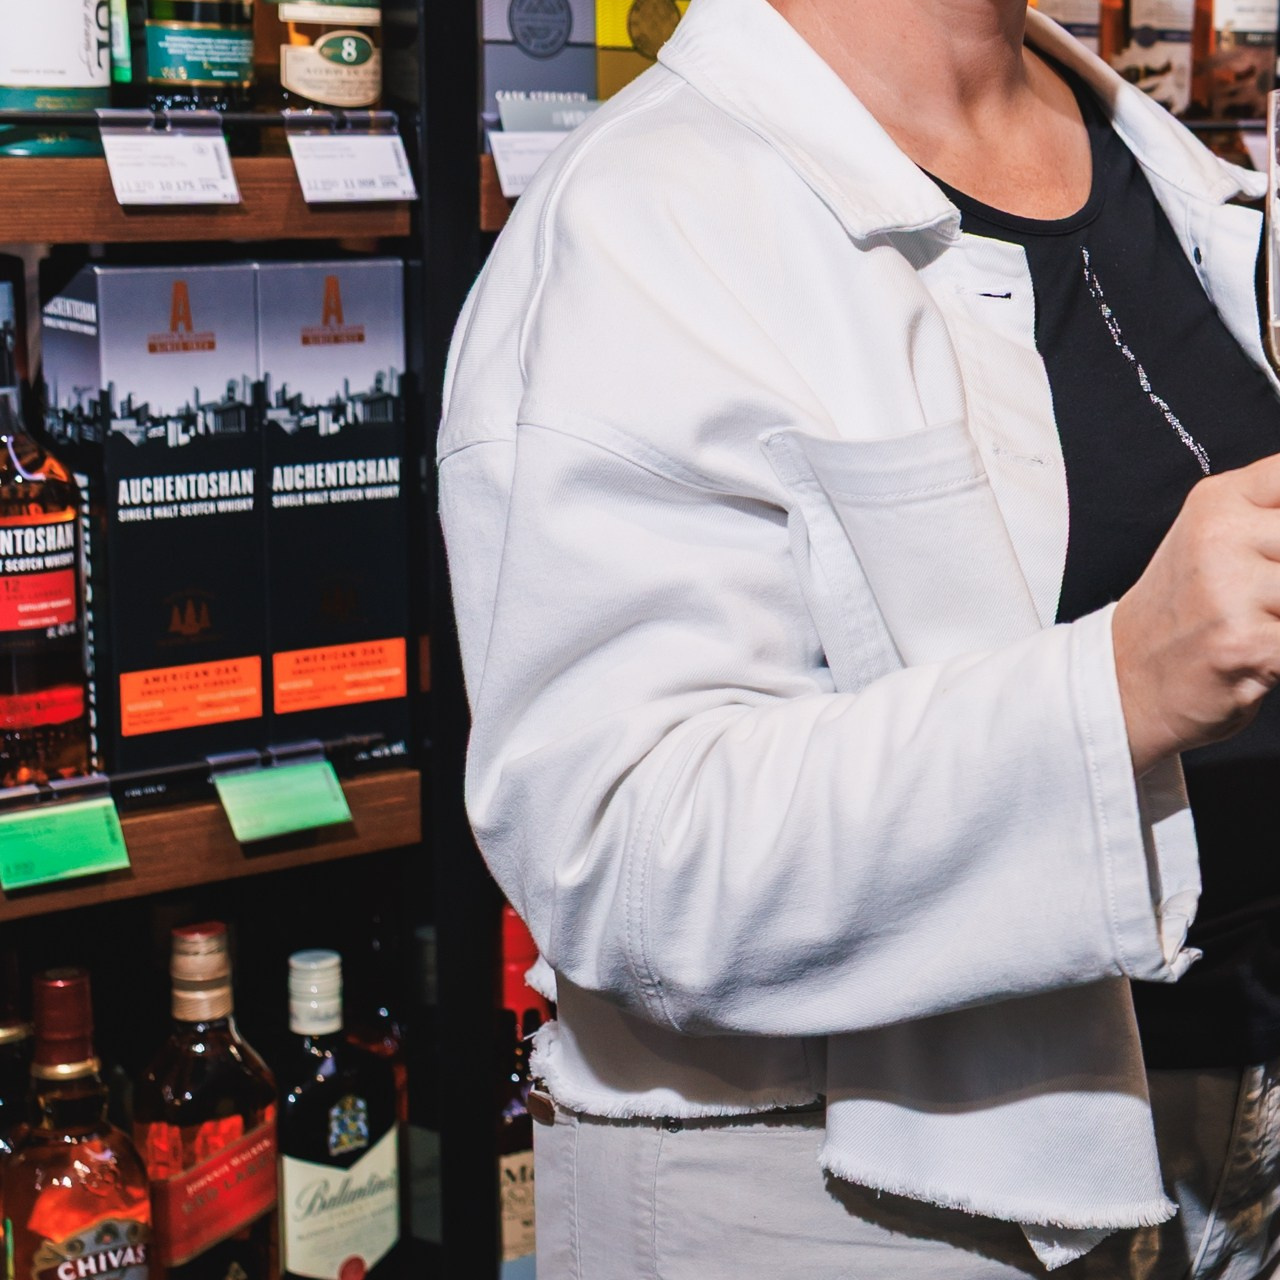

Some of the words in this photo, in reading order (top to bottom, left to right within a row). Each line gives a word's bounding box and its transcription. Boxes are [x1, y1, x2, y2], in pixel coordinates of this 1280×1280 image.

[342, 37, 357, 63] 8
[118, 469, 255, 506] AUCHENTOSHAN
[272, 457, 400, 492] AUCHENTOSHAN
